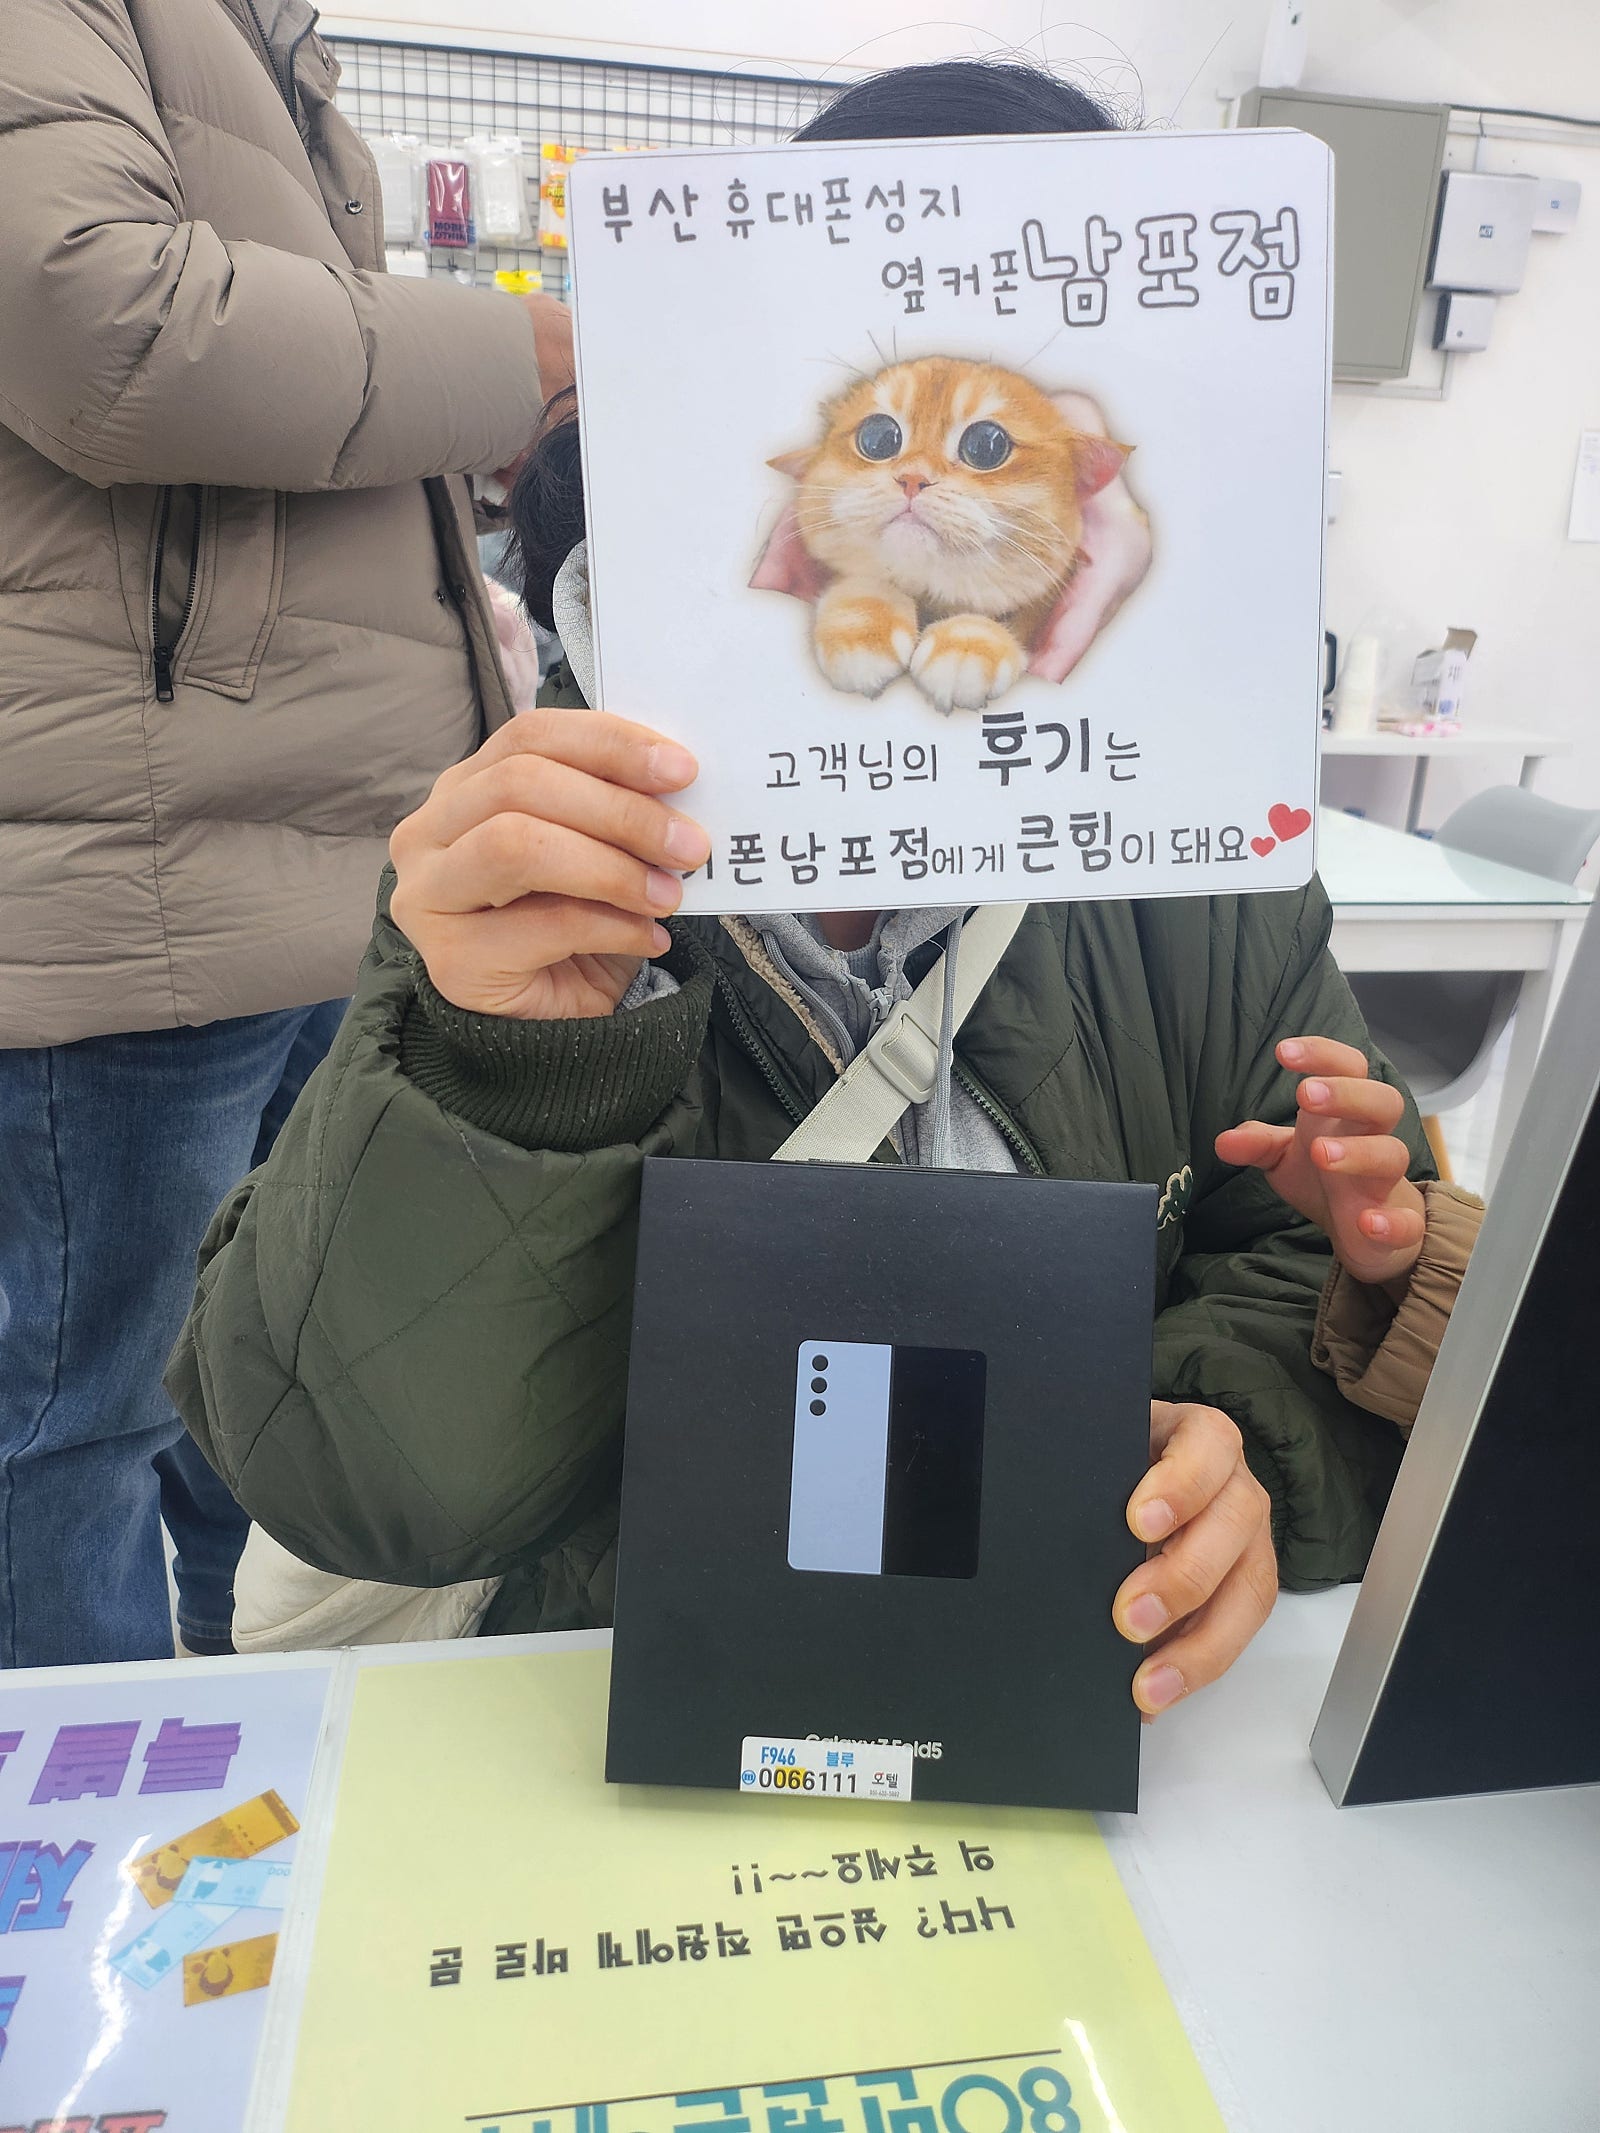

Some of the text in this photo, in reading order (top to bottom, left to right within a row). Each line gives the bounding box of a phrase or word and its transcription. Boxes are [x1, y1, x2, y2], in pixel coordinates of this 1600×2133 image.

[602, 177, 962, 244] 부산 휴대폰성지
[766, 711, 1142, 792] 고객님의 후기는
[1170, 825, 1250, 865] 돼요
[760, 1746, 796, 1766] F946
[825, 1750, 855, 1768] 블루
[759, 1767, 857, 1793] 0066111
[871, 1772, 898, 1789] 오텔
[958, 1840, 995, 1872] 의
[430, 1896, 1015, 1987] 나다? 싶으면 직원에게 바로 문
